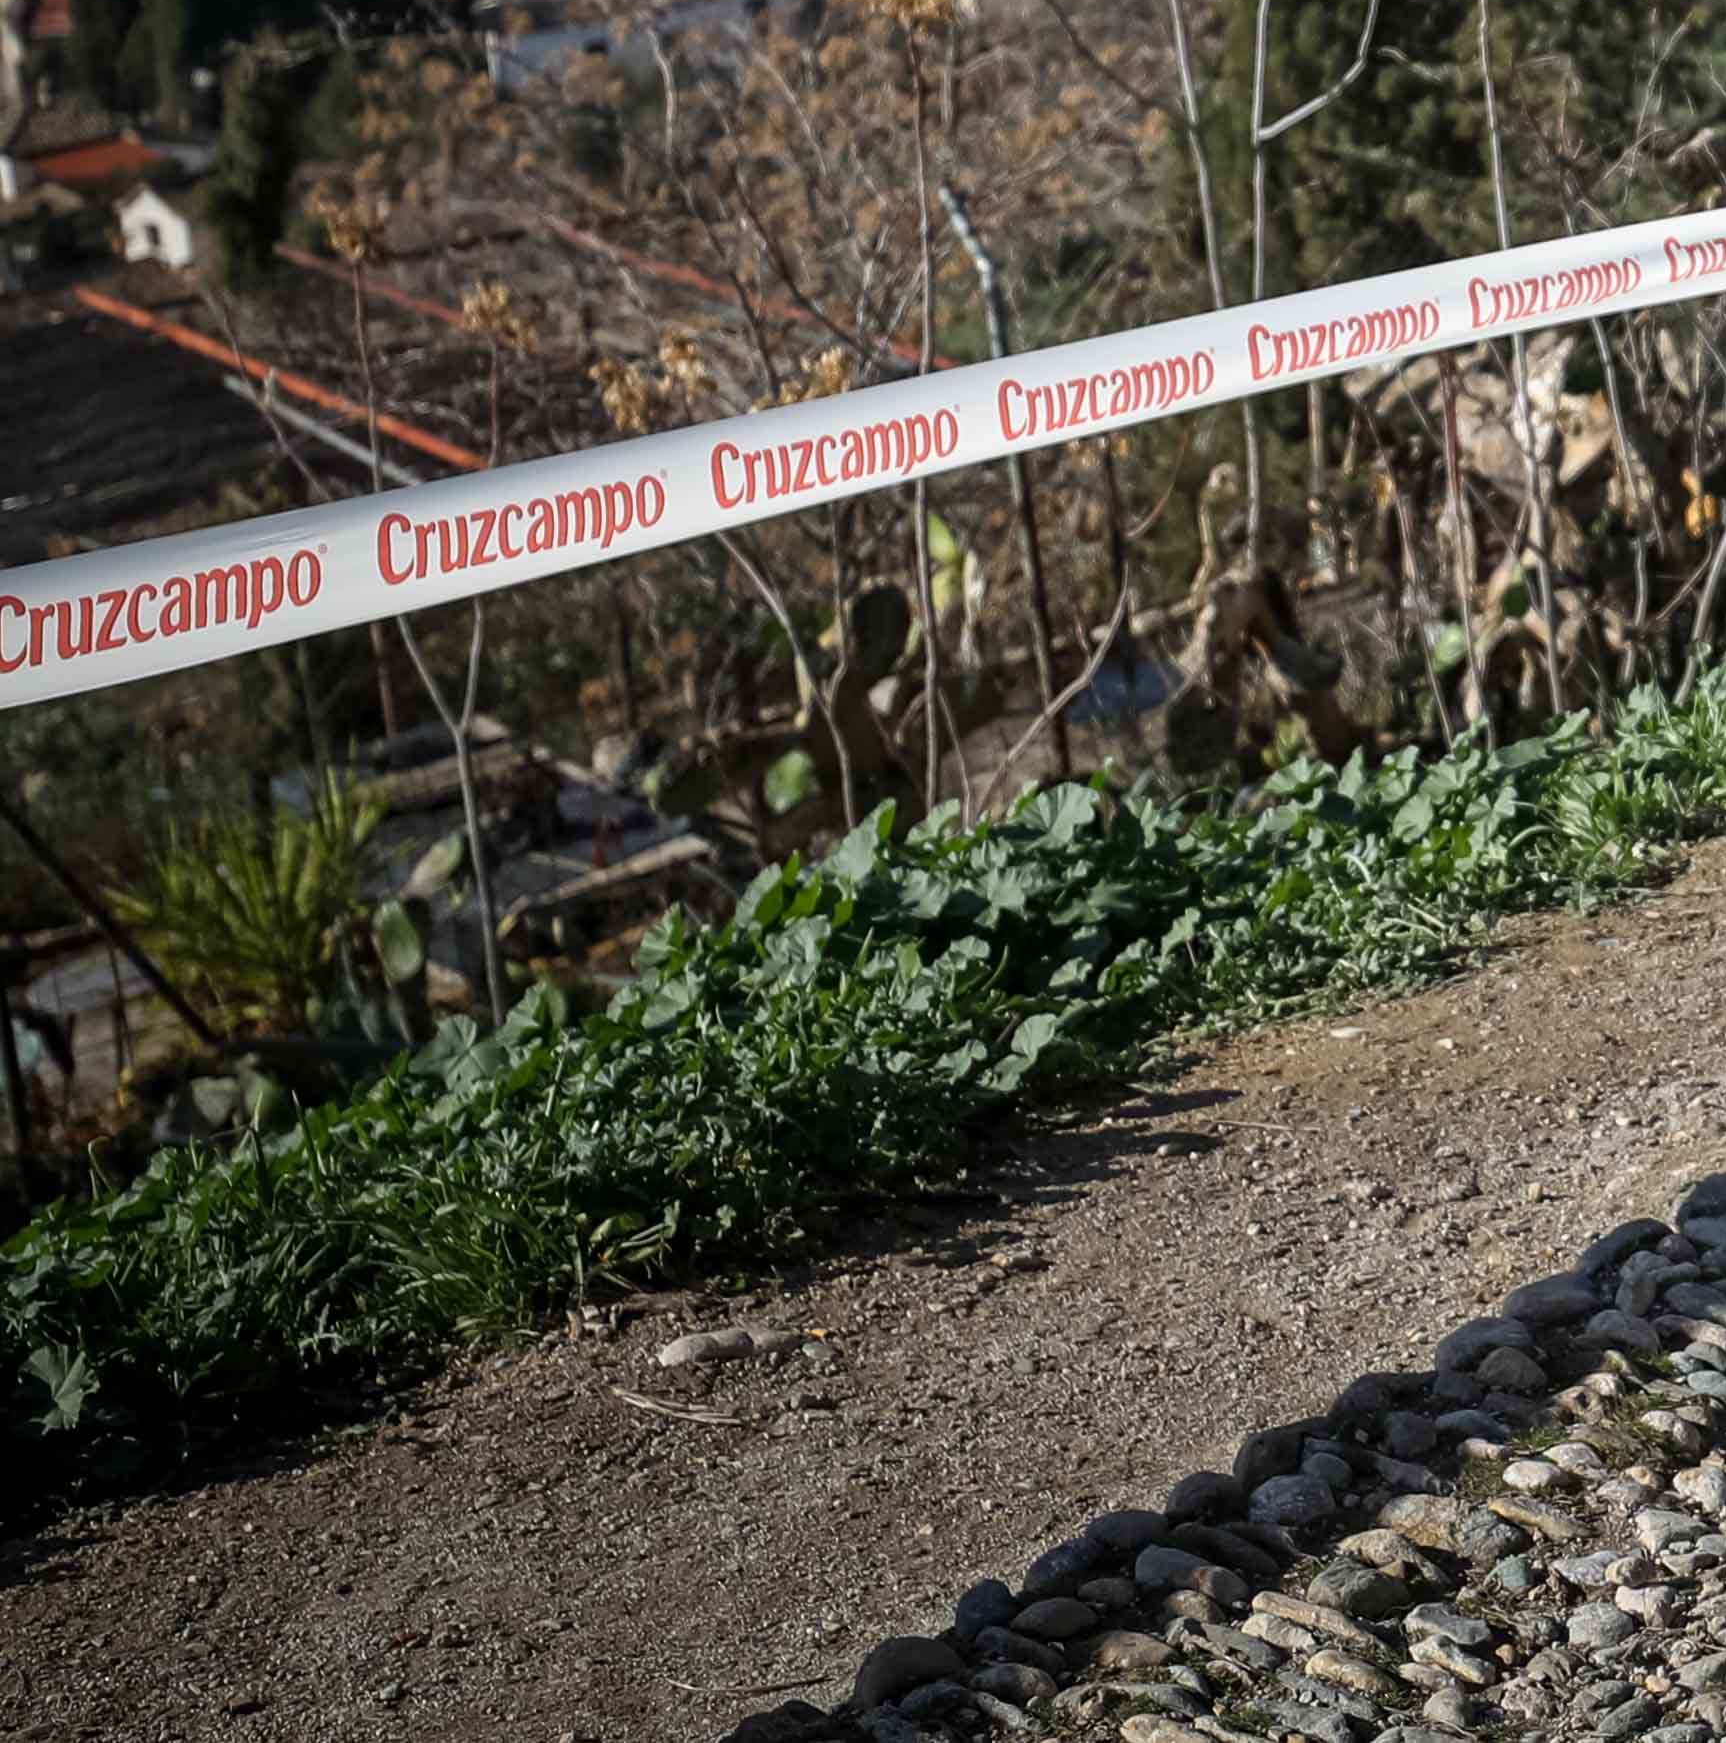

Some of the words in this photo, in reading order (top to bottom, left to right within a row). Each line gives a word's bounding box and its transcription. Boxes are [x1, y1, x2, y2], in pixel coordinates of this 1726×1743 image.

[0, 549, 322, 675] Cruzcampo
[376, 474, 666, 586] Cruzcampo
[710, 408, 960, 509] Cruzcampo
[998, 350, 1216, 441] Cruzcampo
[1246, 300, 1441, 381] Cruzcampo
[1467, 257, 1643, 330] Cruzcampo
